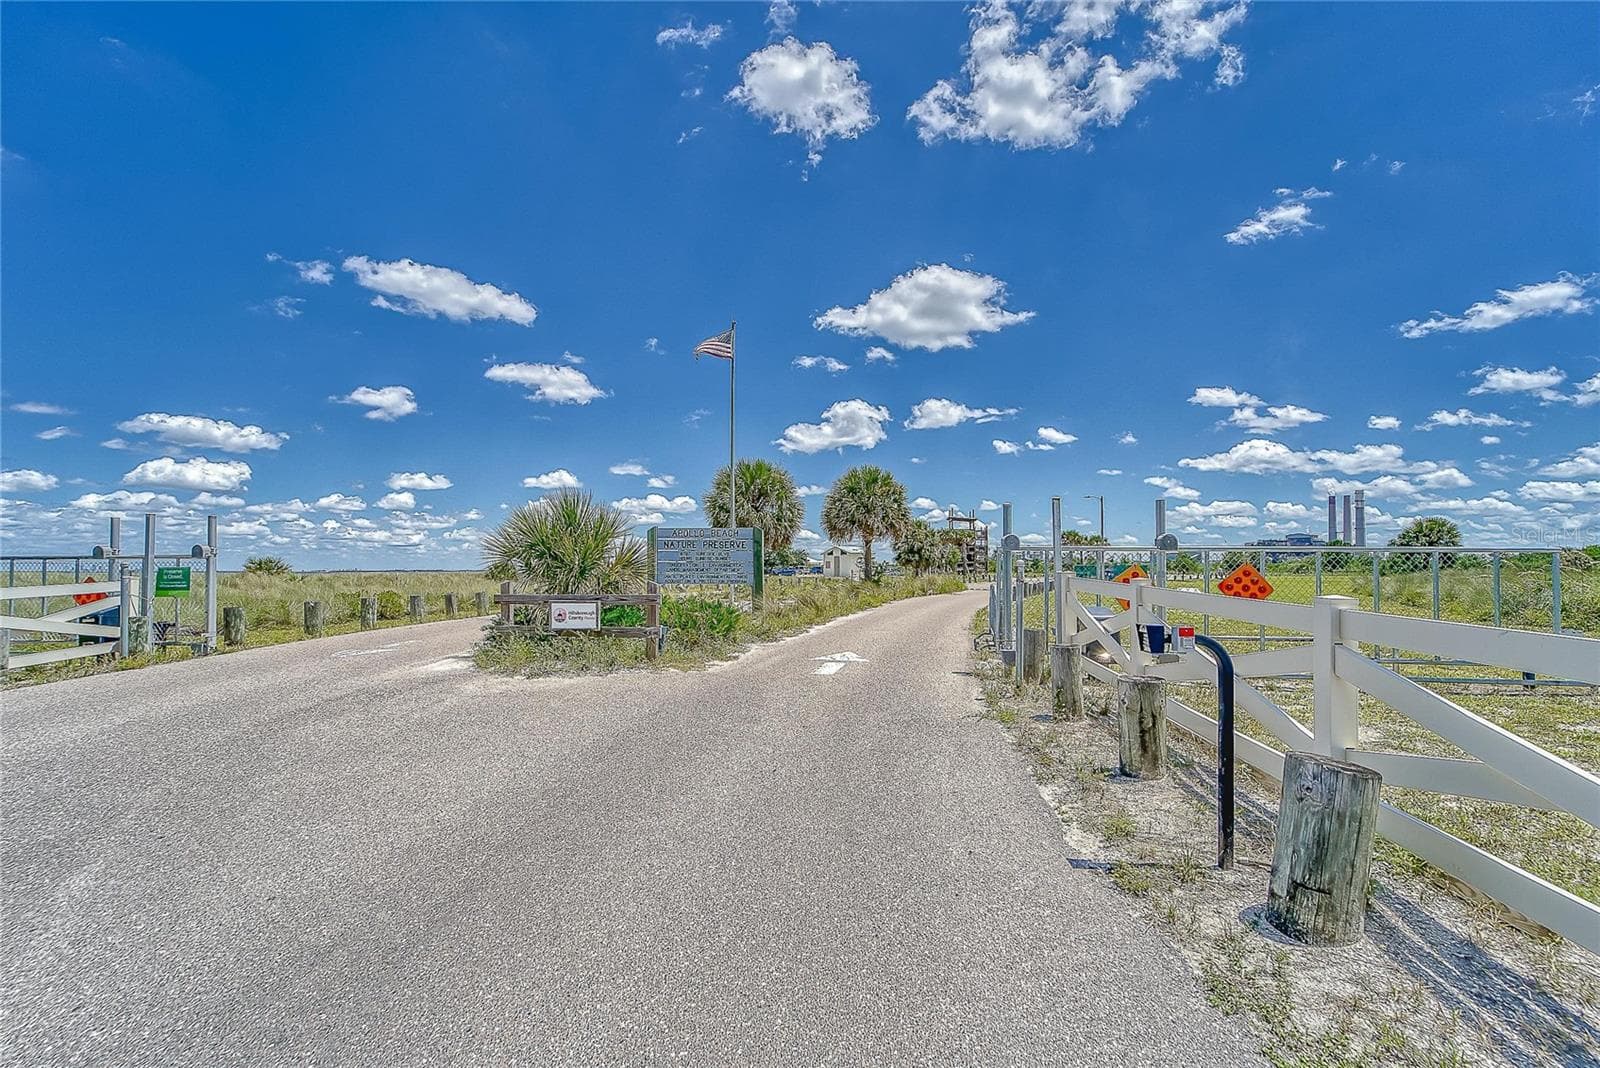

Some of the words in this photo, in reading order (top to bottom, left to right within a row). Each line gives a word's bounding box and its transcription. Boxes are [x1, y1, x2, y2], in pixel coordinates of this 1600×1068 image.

[672, 529, 704, 538] APOLLO
[711, 529, 739, 538] BEACH
[663, 541, 697, 549] NATURE
[703, 541, 747, 549] PRESERVE
